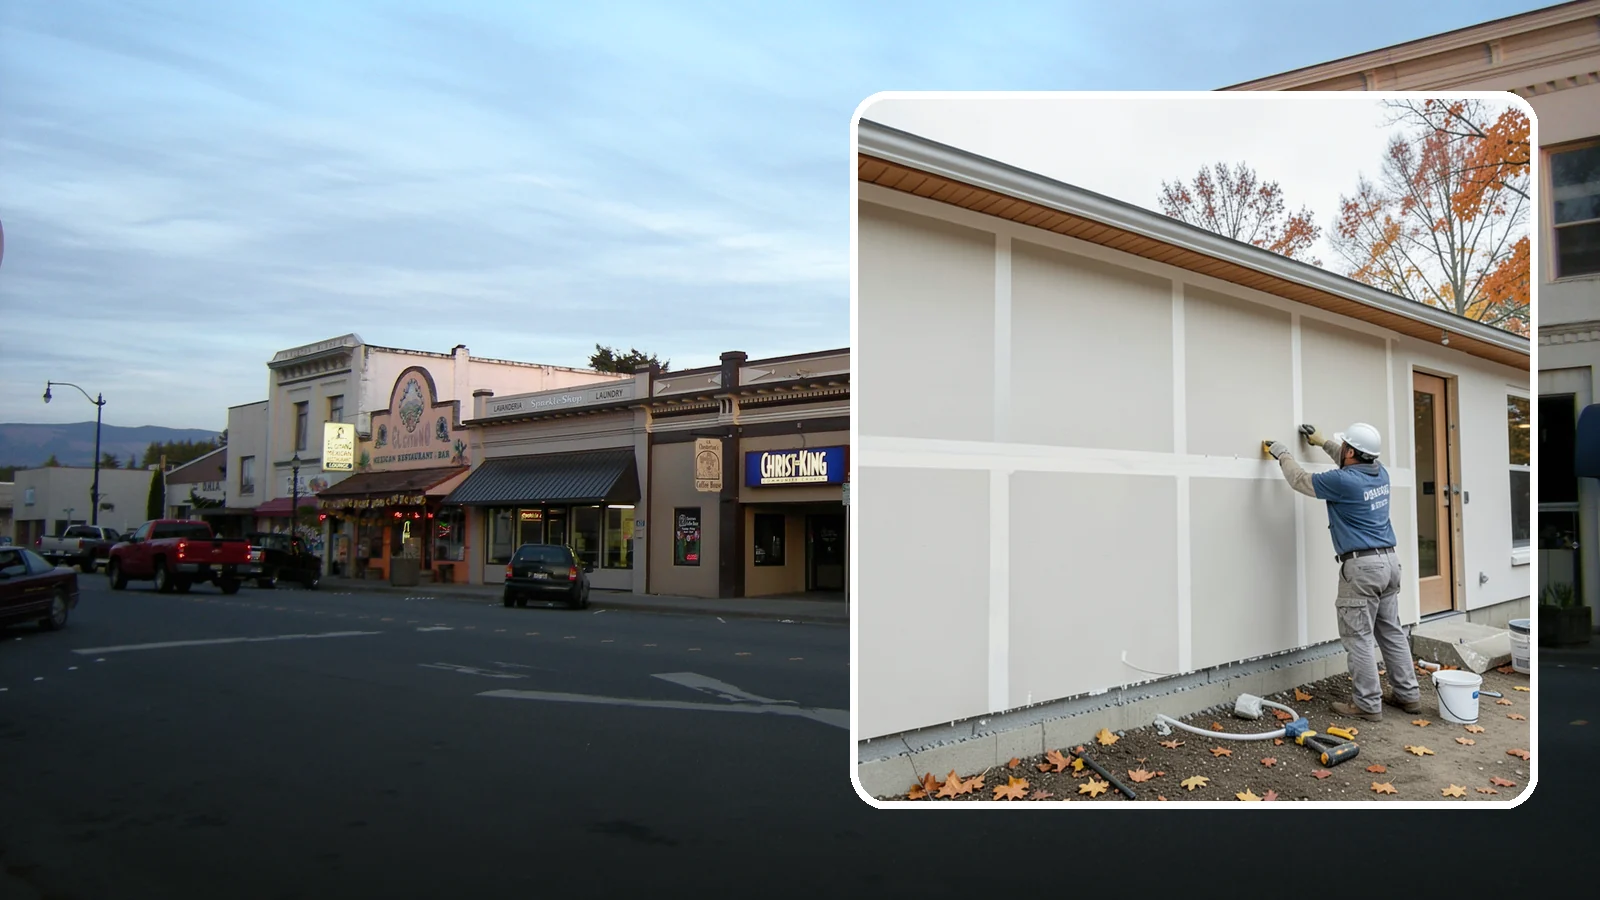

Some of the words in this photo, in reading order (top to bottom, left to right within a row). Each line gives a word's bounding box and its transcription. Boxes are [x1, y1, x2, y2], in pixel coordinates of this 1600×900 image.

[493, 402, 523, 413] LAVANDERIA
[530, 396, 561, 409] Sparkle
[561, 394, 583, 405] Shop
[595, 389, 623, 399] LAUNDRY
[373, 455, 396, 464] MEXICAN
[397, 451, 434, 462] RESTAURANT
[437, 449, 450, 459] BAR
[760, 452, 797, 477] CHRIST
[799, 450, 827, 476] KING
